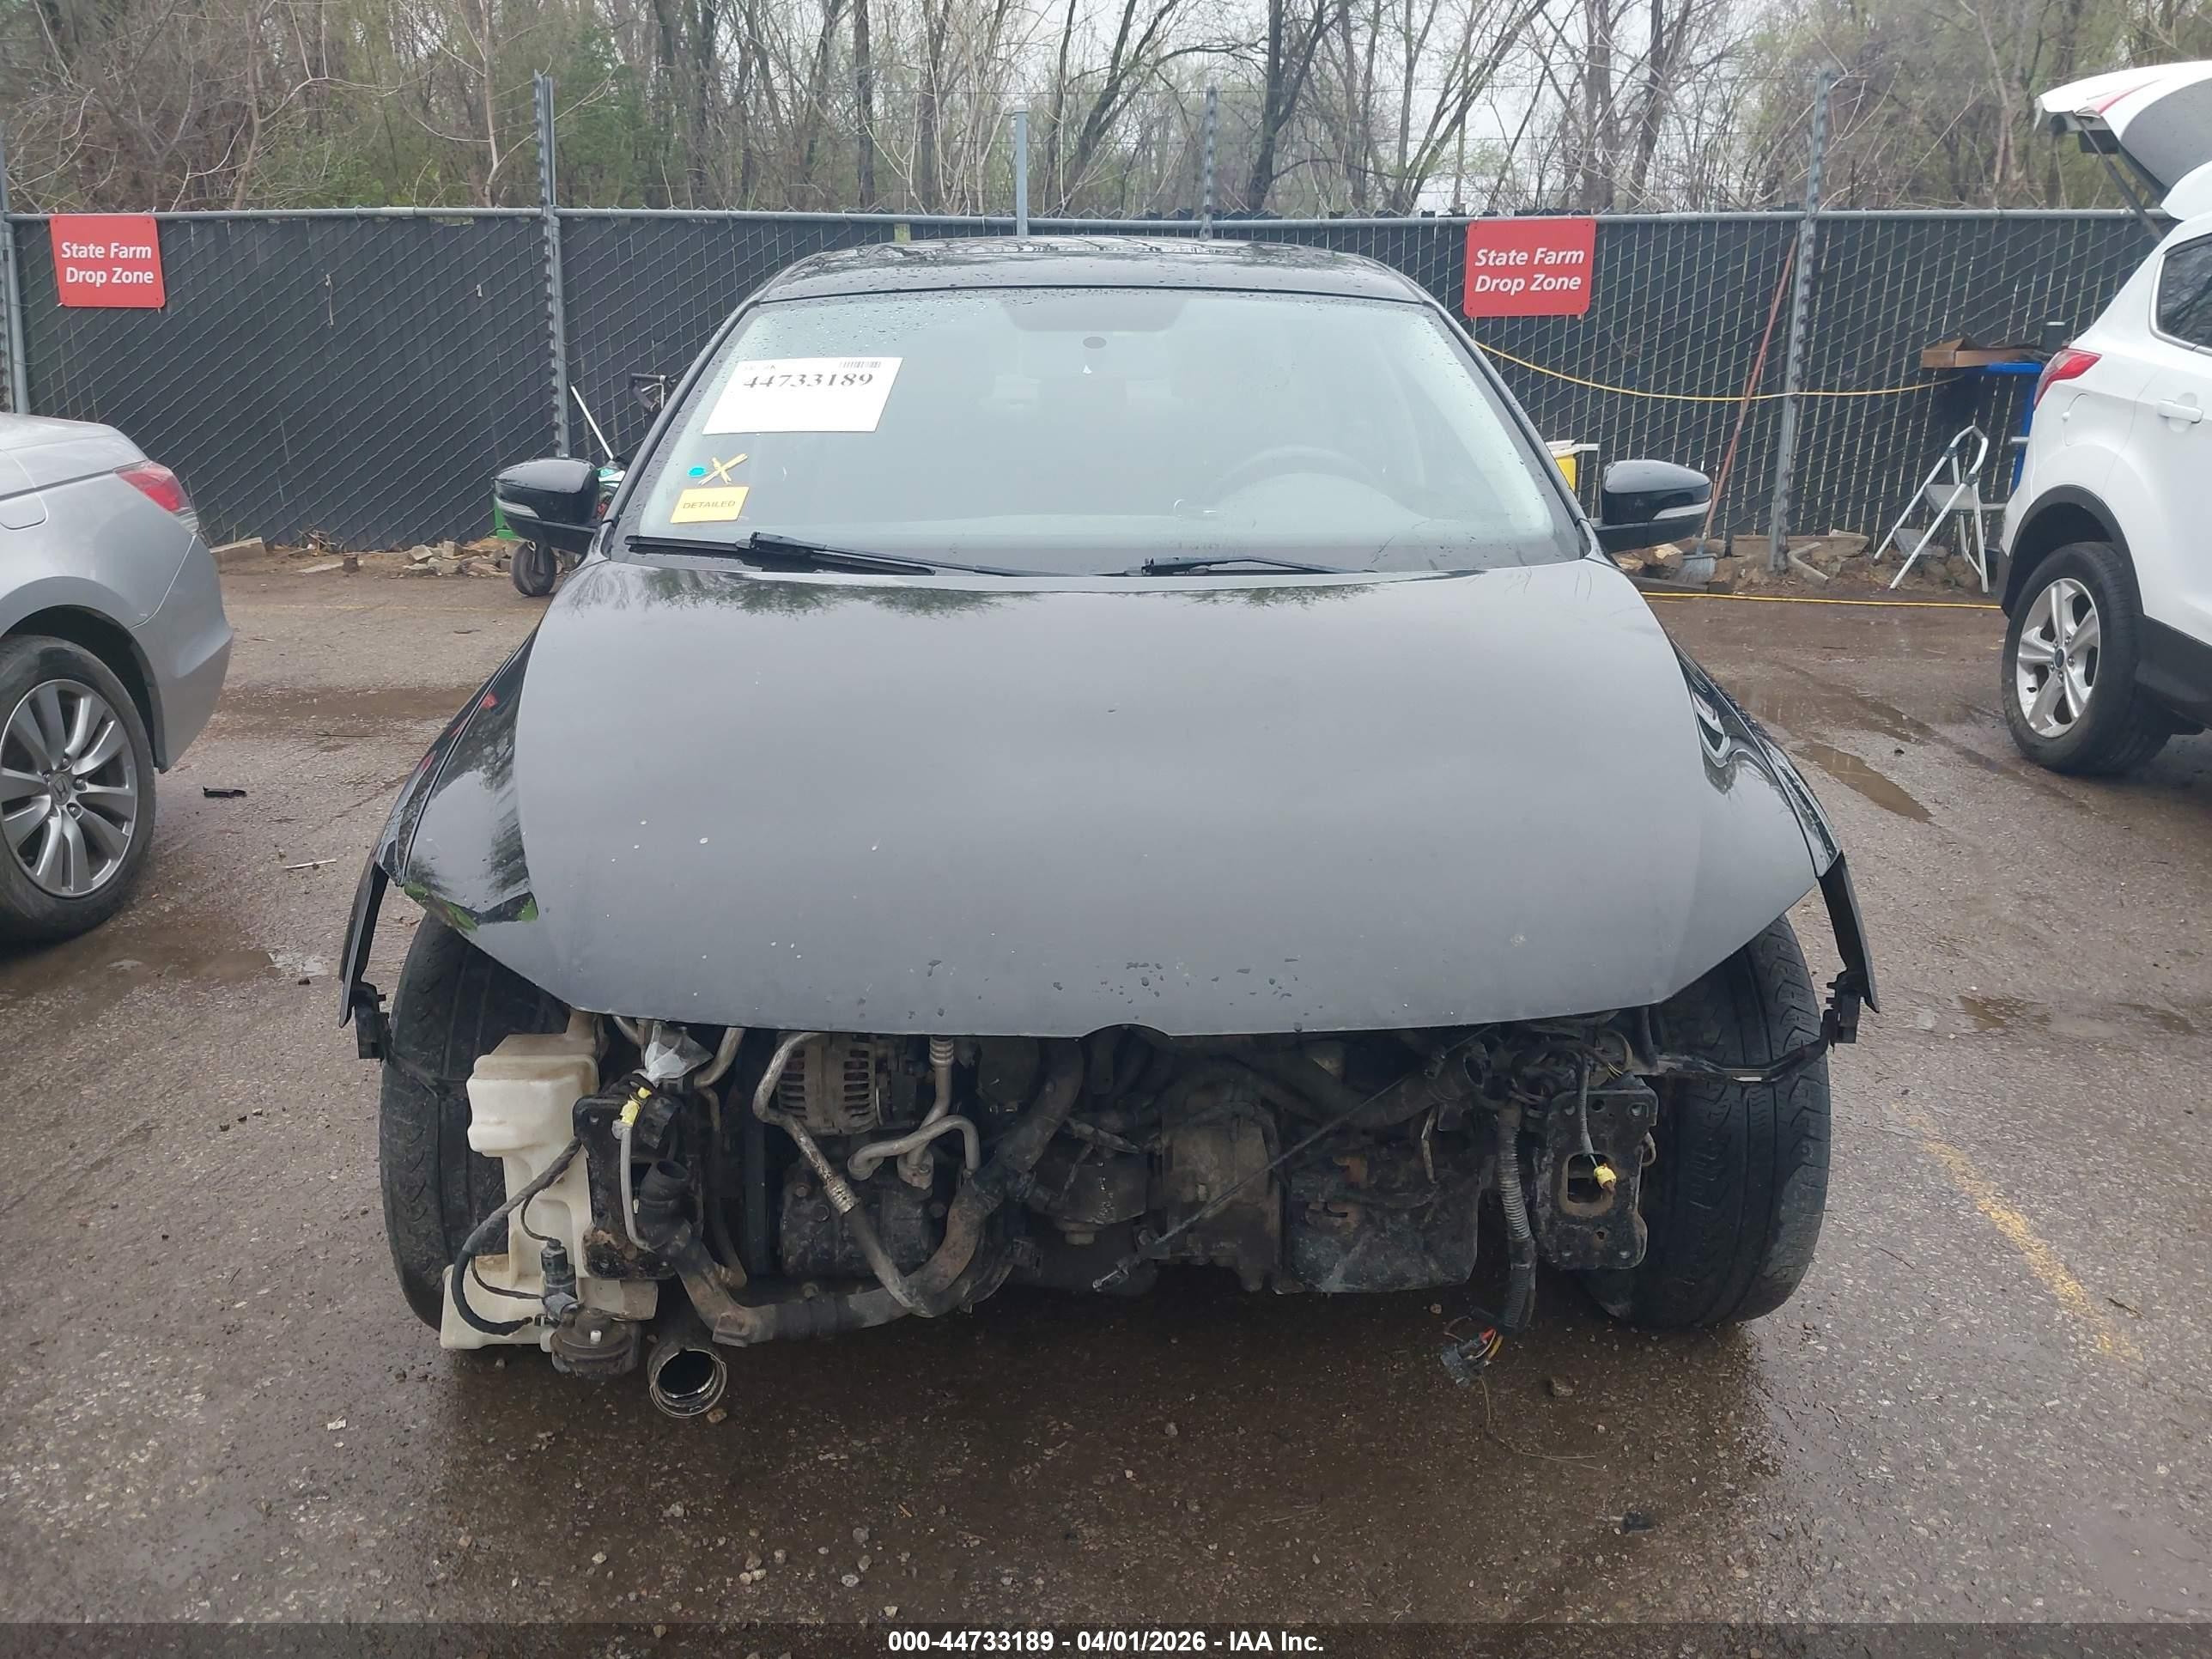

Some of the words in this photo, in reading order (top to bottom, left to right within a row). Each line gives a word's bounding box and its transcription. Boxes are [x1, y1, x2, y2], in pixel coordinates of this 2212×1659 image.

[61, 241, 106, 258] State
[109, 242, 152, 259] Farm
[1474, 248, 1528, 267] State
[1533, 247, 1585, 265] Farm
[65, 266, 107, 288] Drop
[111, 267, 155, 284] Zone
[1474, 275, 1526, 296] Drop
[1529, 273, 1582, 292] Zone
[743, 373, 874, 388] 44733189
[682, 500, 736, 509] DETAILED
